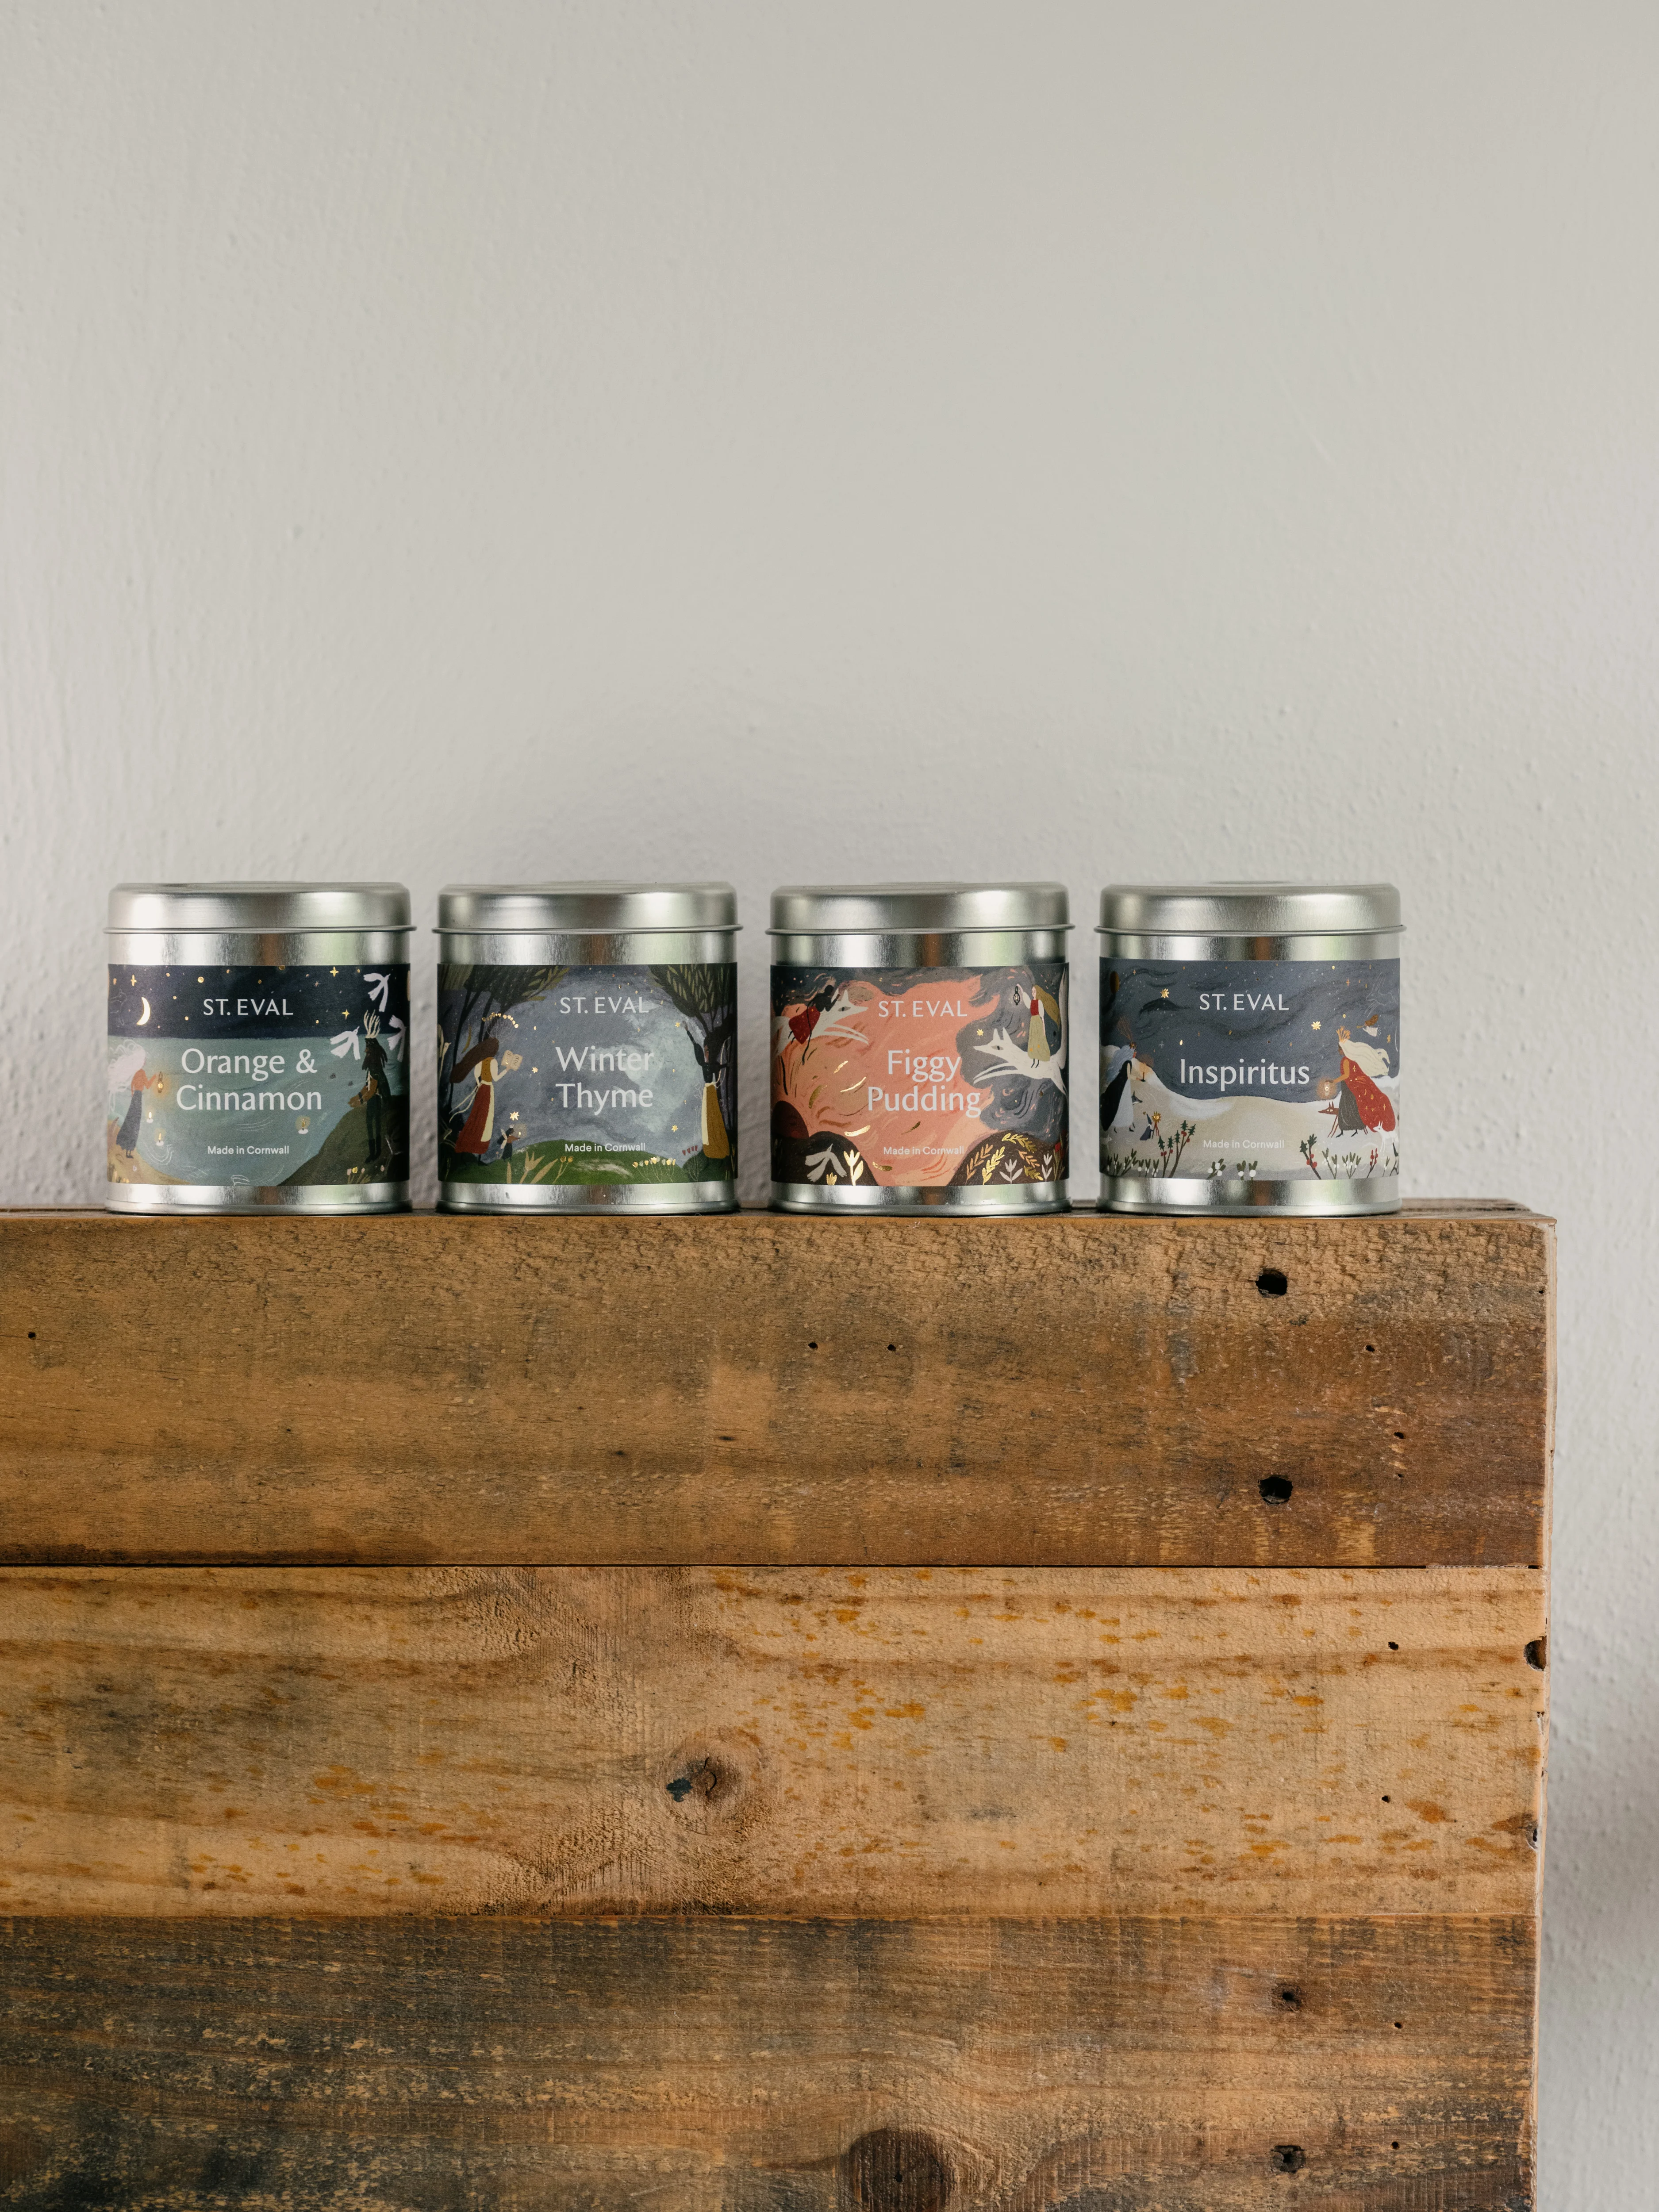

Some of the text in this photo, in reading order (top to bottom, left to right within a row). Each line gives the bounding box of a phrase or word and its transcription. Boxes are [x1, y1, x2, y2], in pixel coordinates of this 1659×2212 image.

[203, 999, 293, 1015] ST. EVAL
[560, 997, 649, 1014] ST. EVAL
[879, 1000, 968, 1017] ST. EVAL
[1200, 994, 1289, 1010] ST. EVAL
[181, 1048, 317, 1081] Orange &
[556, 1045, 653, 1071] Winter
[888, 1049, 961, 1082] Figgy
[1180, 1058, 1310, 1091] Inspiritus
[177, 1084, 322, 1110] Cinnamon
[556, 1082, 653, 1115] Thyme
[868, 1085, 981, 1118] Pudding
[207, 1146, 289, 1154] Made in Cornwall
[565, 1144, 591, 1152] Made
[605, 1143, 645, 1151] Cornwall
[883, 1146, 964, 1155] Made in Cornwall
[1203, 1140, 1284, 1148] Made in Cornwall
